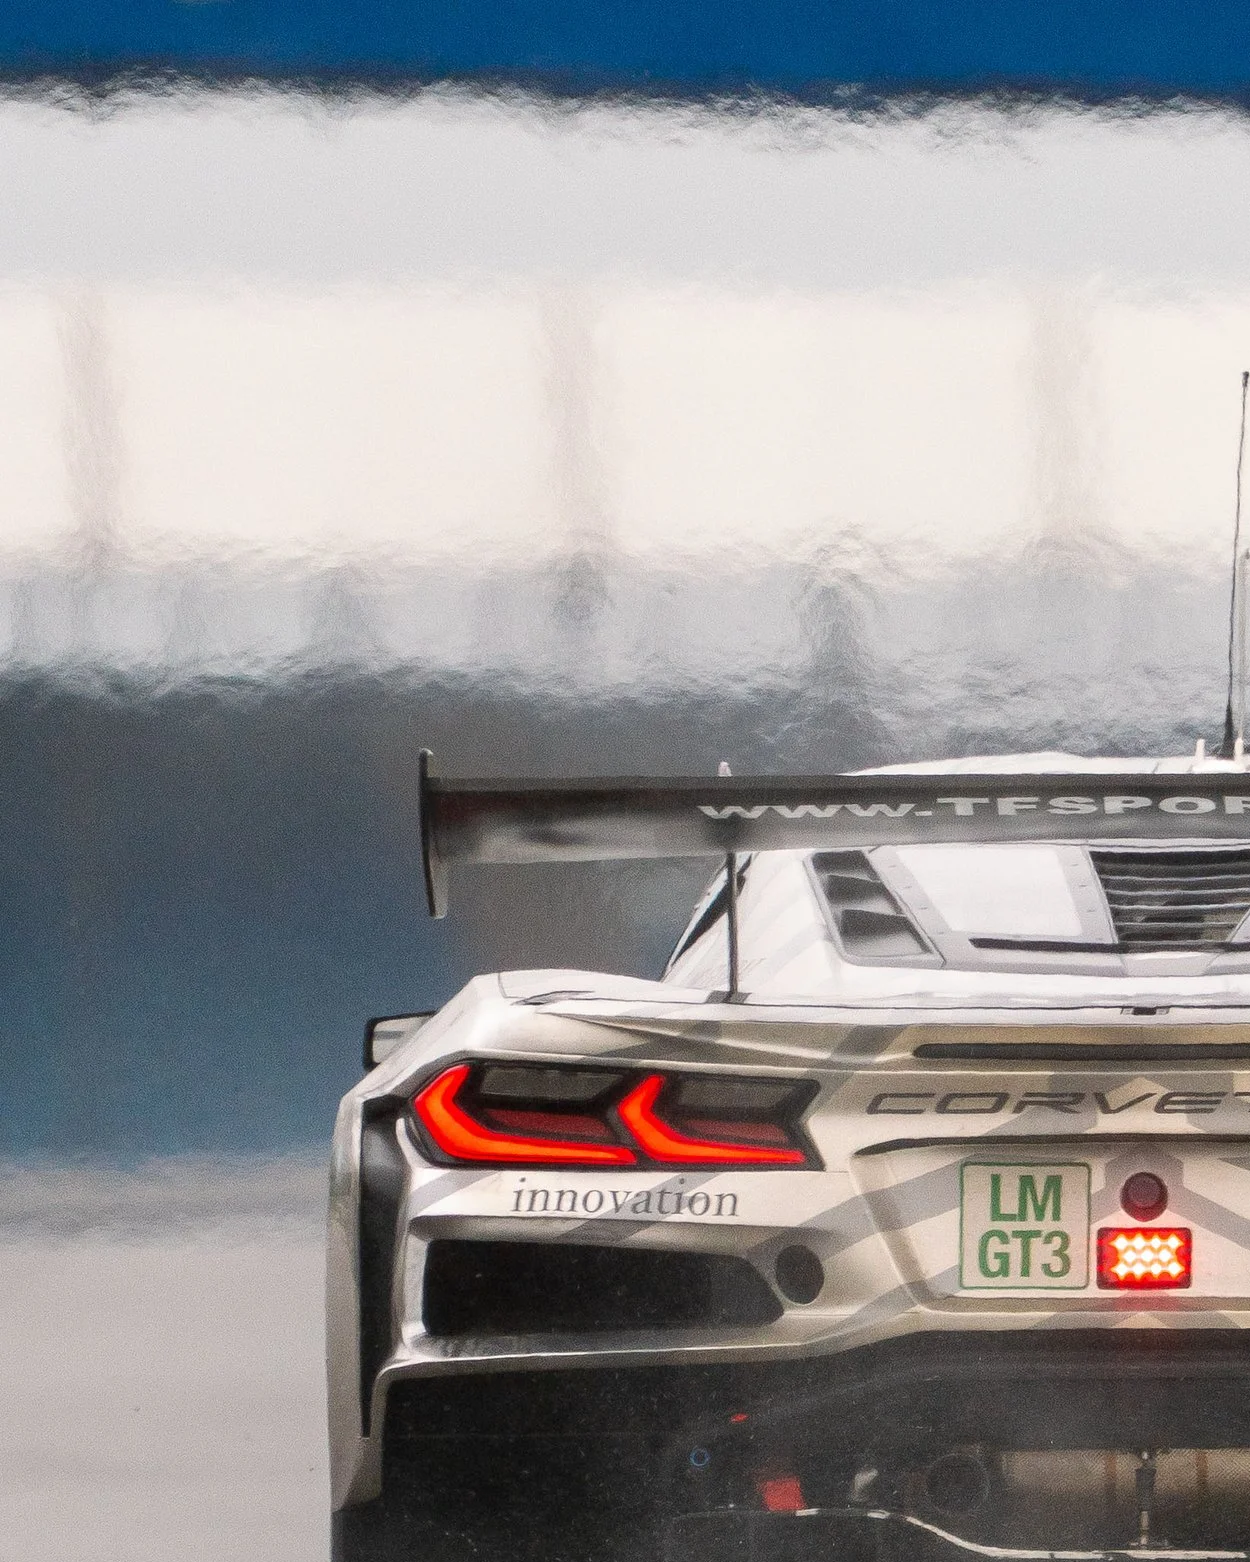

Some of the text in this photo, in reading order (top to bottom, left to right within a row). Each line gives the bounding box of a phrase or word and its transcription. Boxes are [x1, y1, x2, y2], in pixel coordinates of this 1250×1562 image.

[511, 1176, 740, 1217] innovation
[990, 1173, 1063, 1222] LM
[978, 1228, 1071, 1279] GT3
